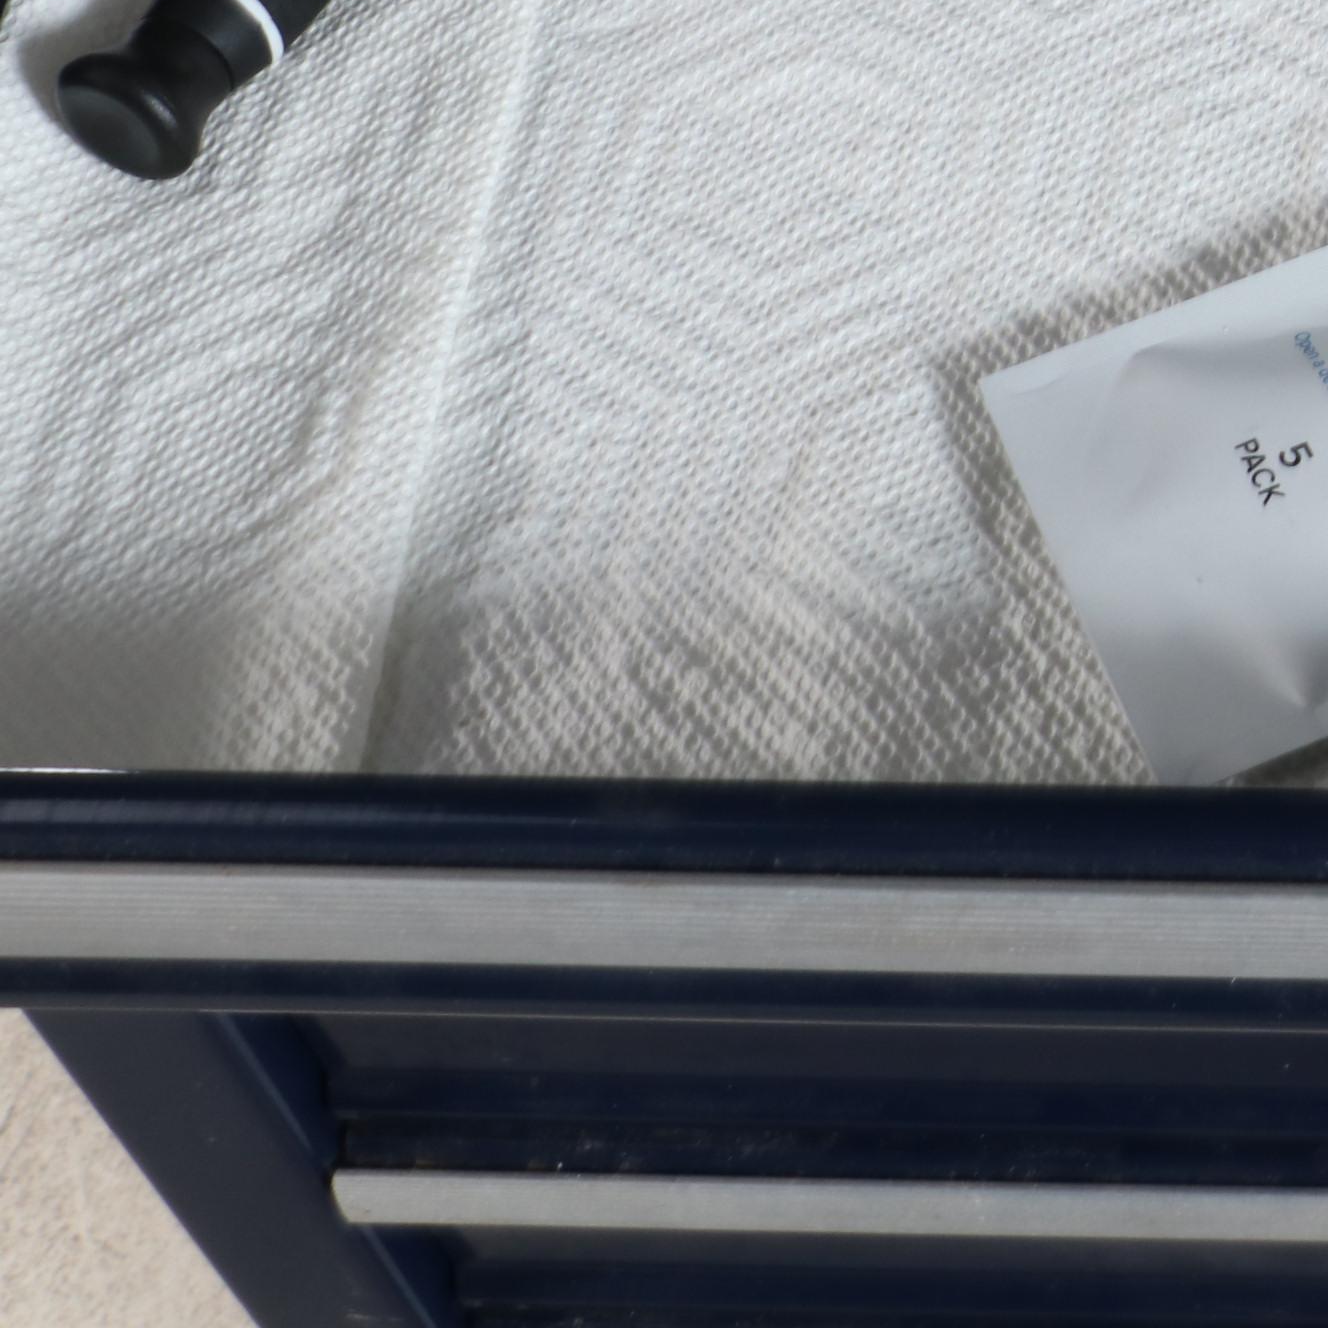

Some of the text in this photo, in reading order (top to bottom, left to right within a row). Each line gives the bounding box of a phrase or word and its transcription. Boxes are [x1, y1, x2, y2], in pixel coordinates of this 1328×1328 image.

[1294, 330, 1320, 363] Open
[1312, 357, 1326, 369] a
[1234, 437, 1286, 507] PACK
[1278, 441, 1314, 468] 5
